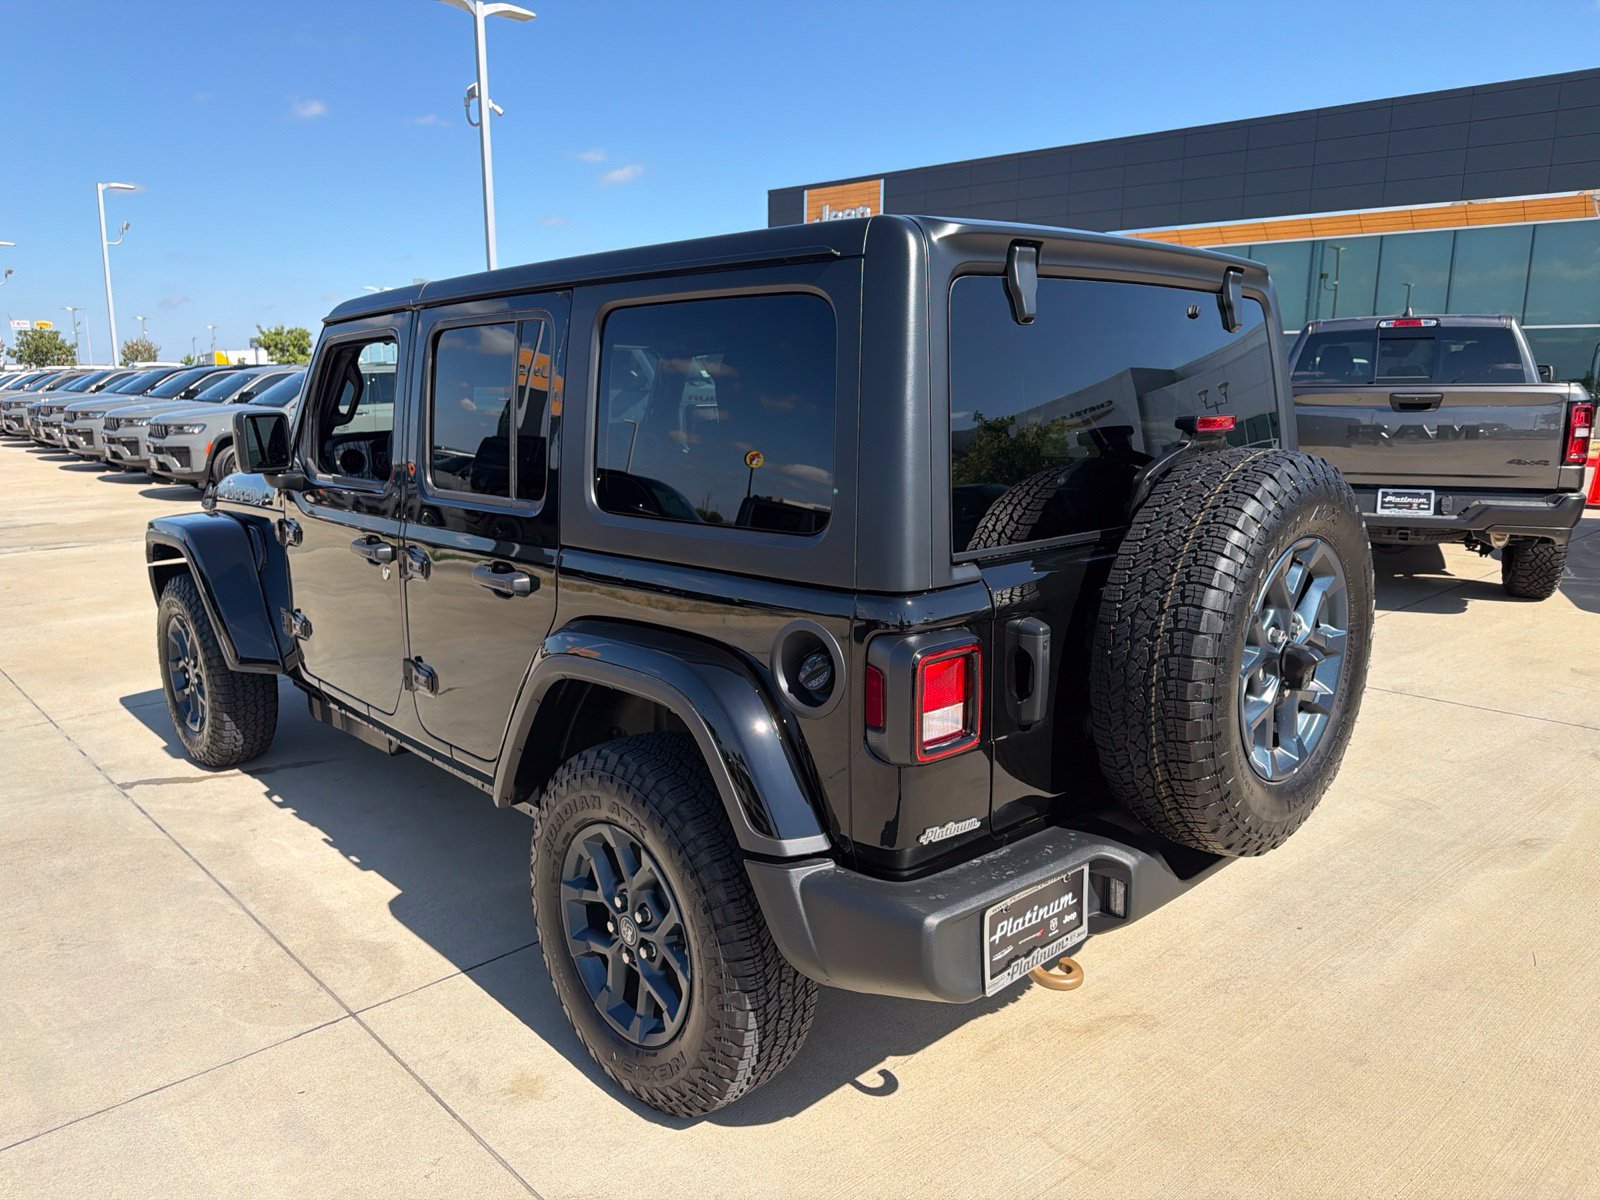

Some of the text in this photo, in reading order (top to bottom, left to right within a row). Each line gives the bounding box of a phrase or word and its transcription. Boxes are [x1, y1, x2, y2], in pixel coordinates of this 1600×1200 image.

[1347, 424, 1480, 440] RAM
[1382, 495, 1430, 504] Platinum
[920, 818, 980, 845] Platinum
[990, 892, 1077, 945] Platinum
[1010, 940, 1068, 981] Platinum
